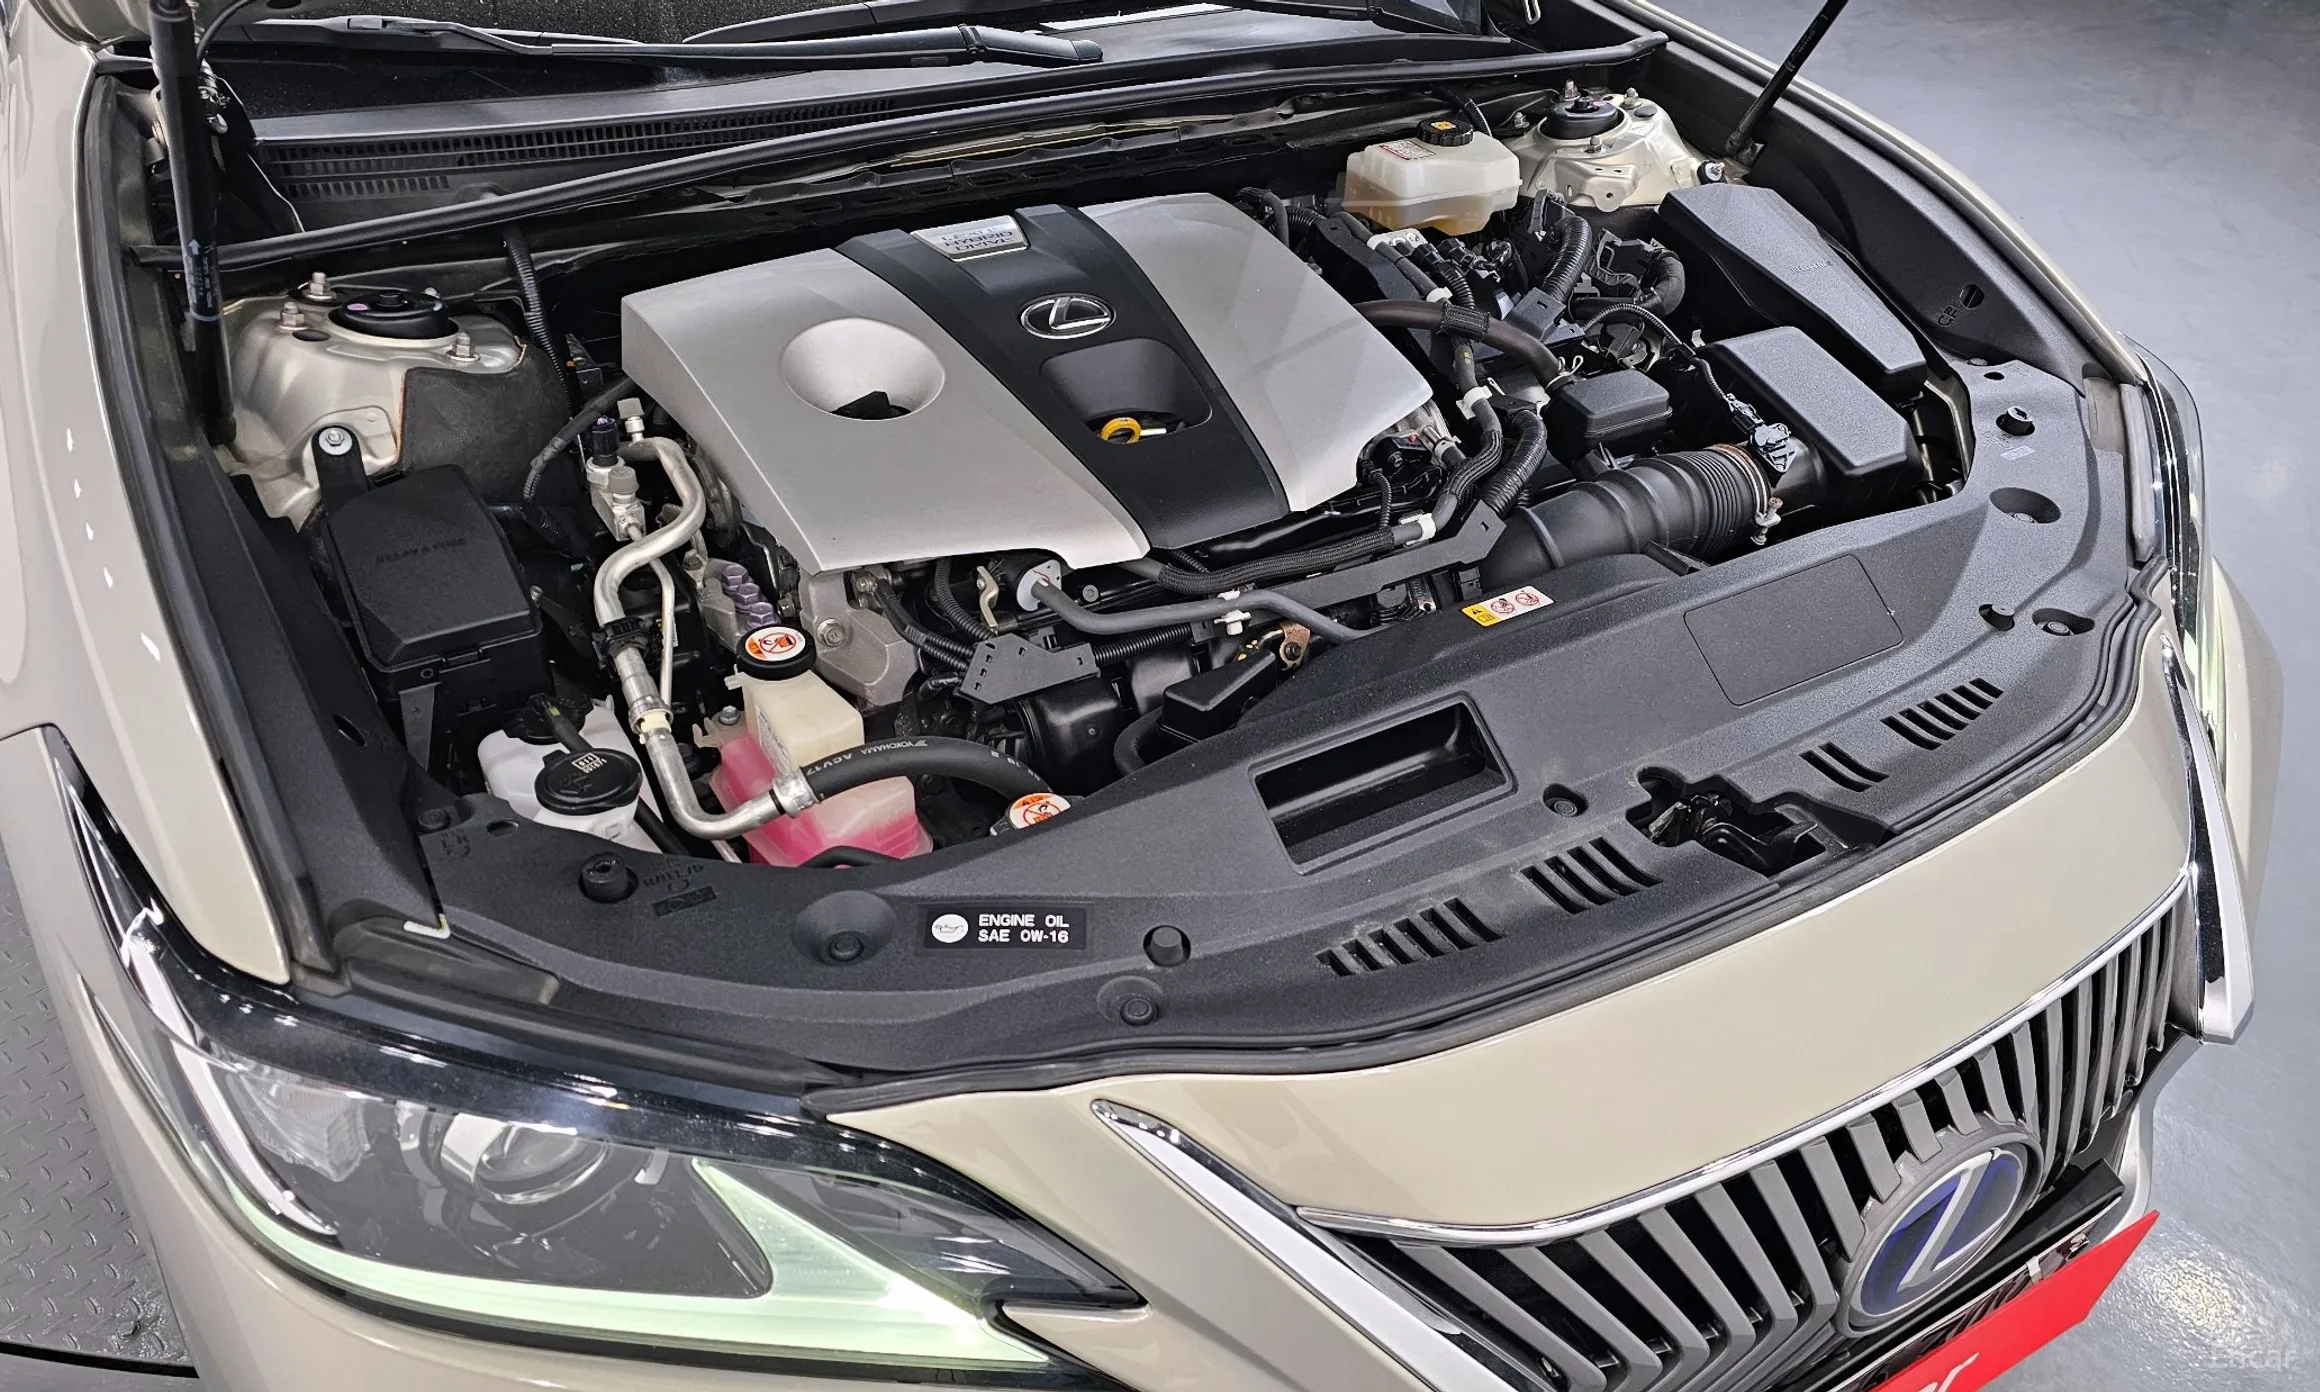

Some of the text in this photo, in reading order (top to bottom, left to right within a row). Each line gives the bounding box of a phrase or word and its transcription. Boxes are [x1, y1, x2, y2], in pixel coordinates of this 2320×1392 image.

[945, 230, 1013, 247] HYBRID
[860, 741, 914, 755] YOKOHAMA
[978, 913, 1070, 928] ENGINE OIL
[977, 928, 1069, 944] SAE 0W-16
